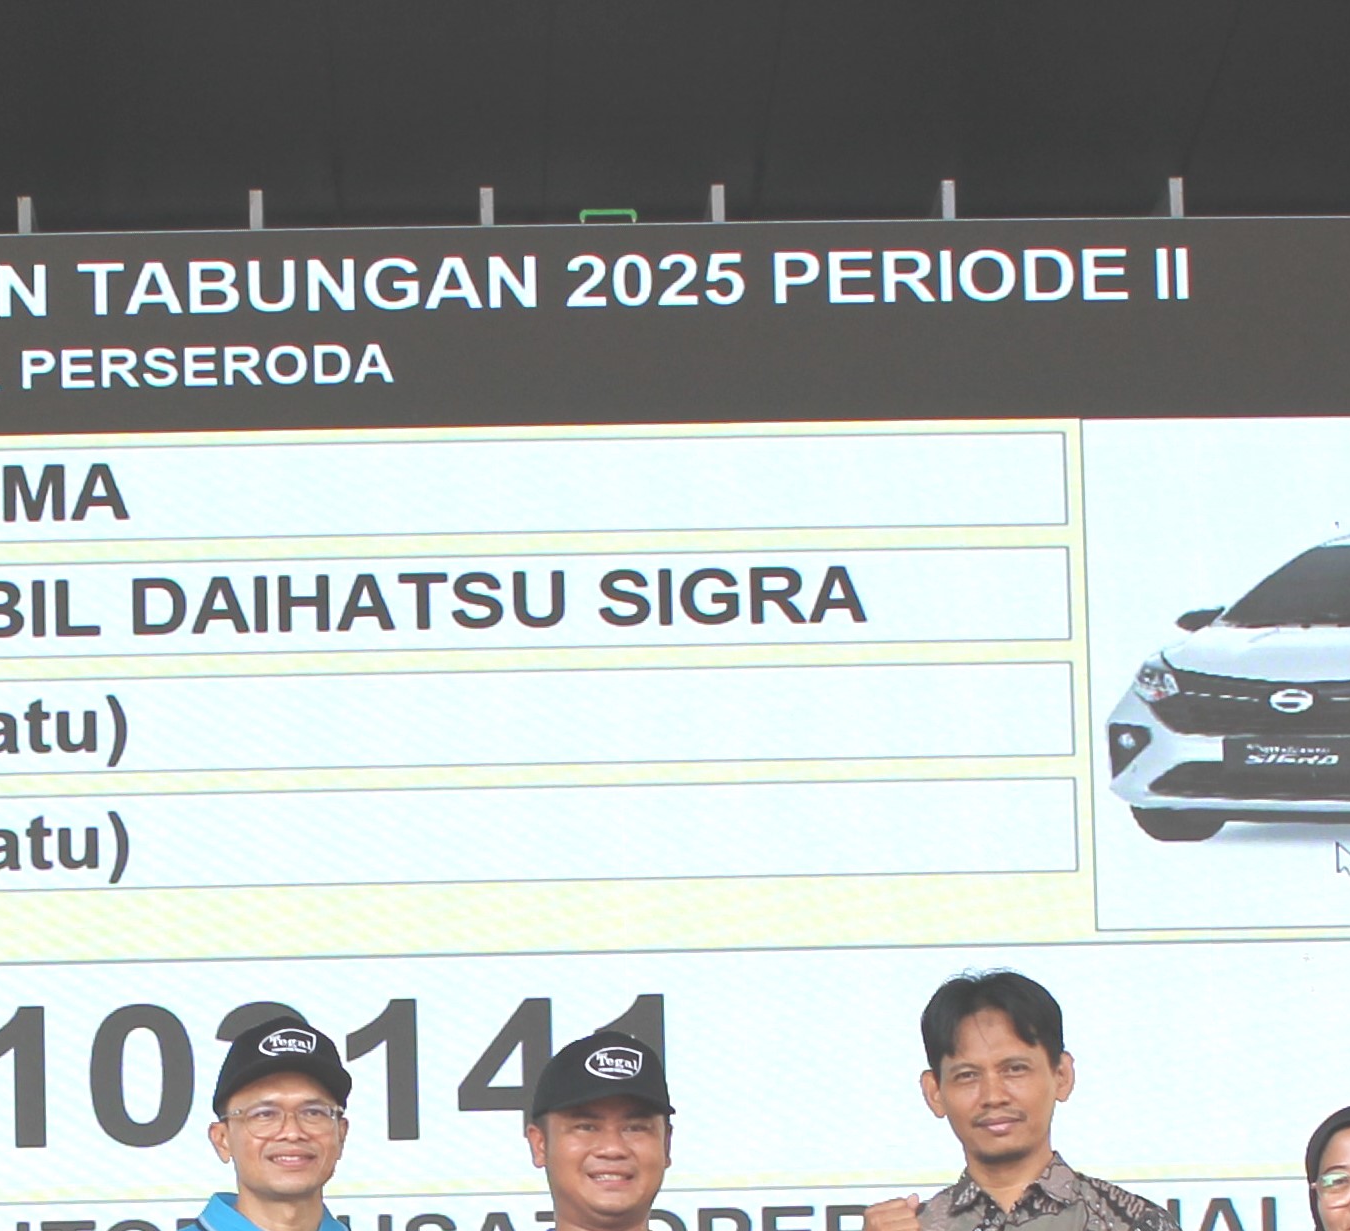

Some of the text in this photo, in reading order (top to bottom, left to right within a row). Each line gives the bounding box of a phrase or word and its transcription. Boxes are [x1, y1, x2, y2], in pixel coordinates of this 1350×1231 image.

[76, 255, 538, 317] TABUNGAN
[566, 252, 746, 308] 2025
[772, 248, 1129, 304] PERIODE
[1155, 247, 1190, 300] II
[20, 344, 395, 390] PERSERODA
[131, 571, 567, 636] DAIHATSU
[597, 566, 868, 628] SIGRA
